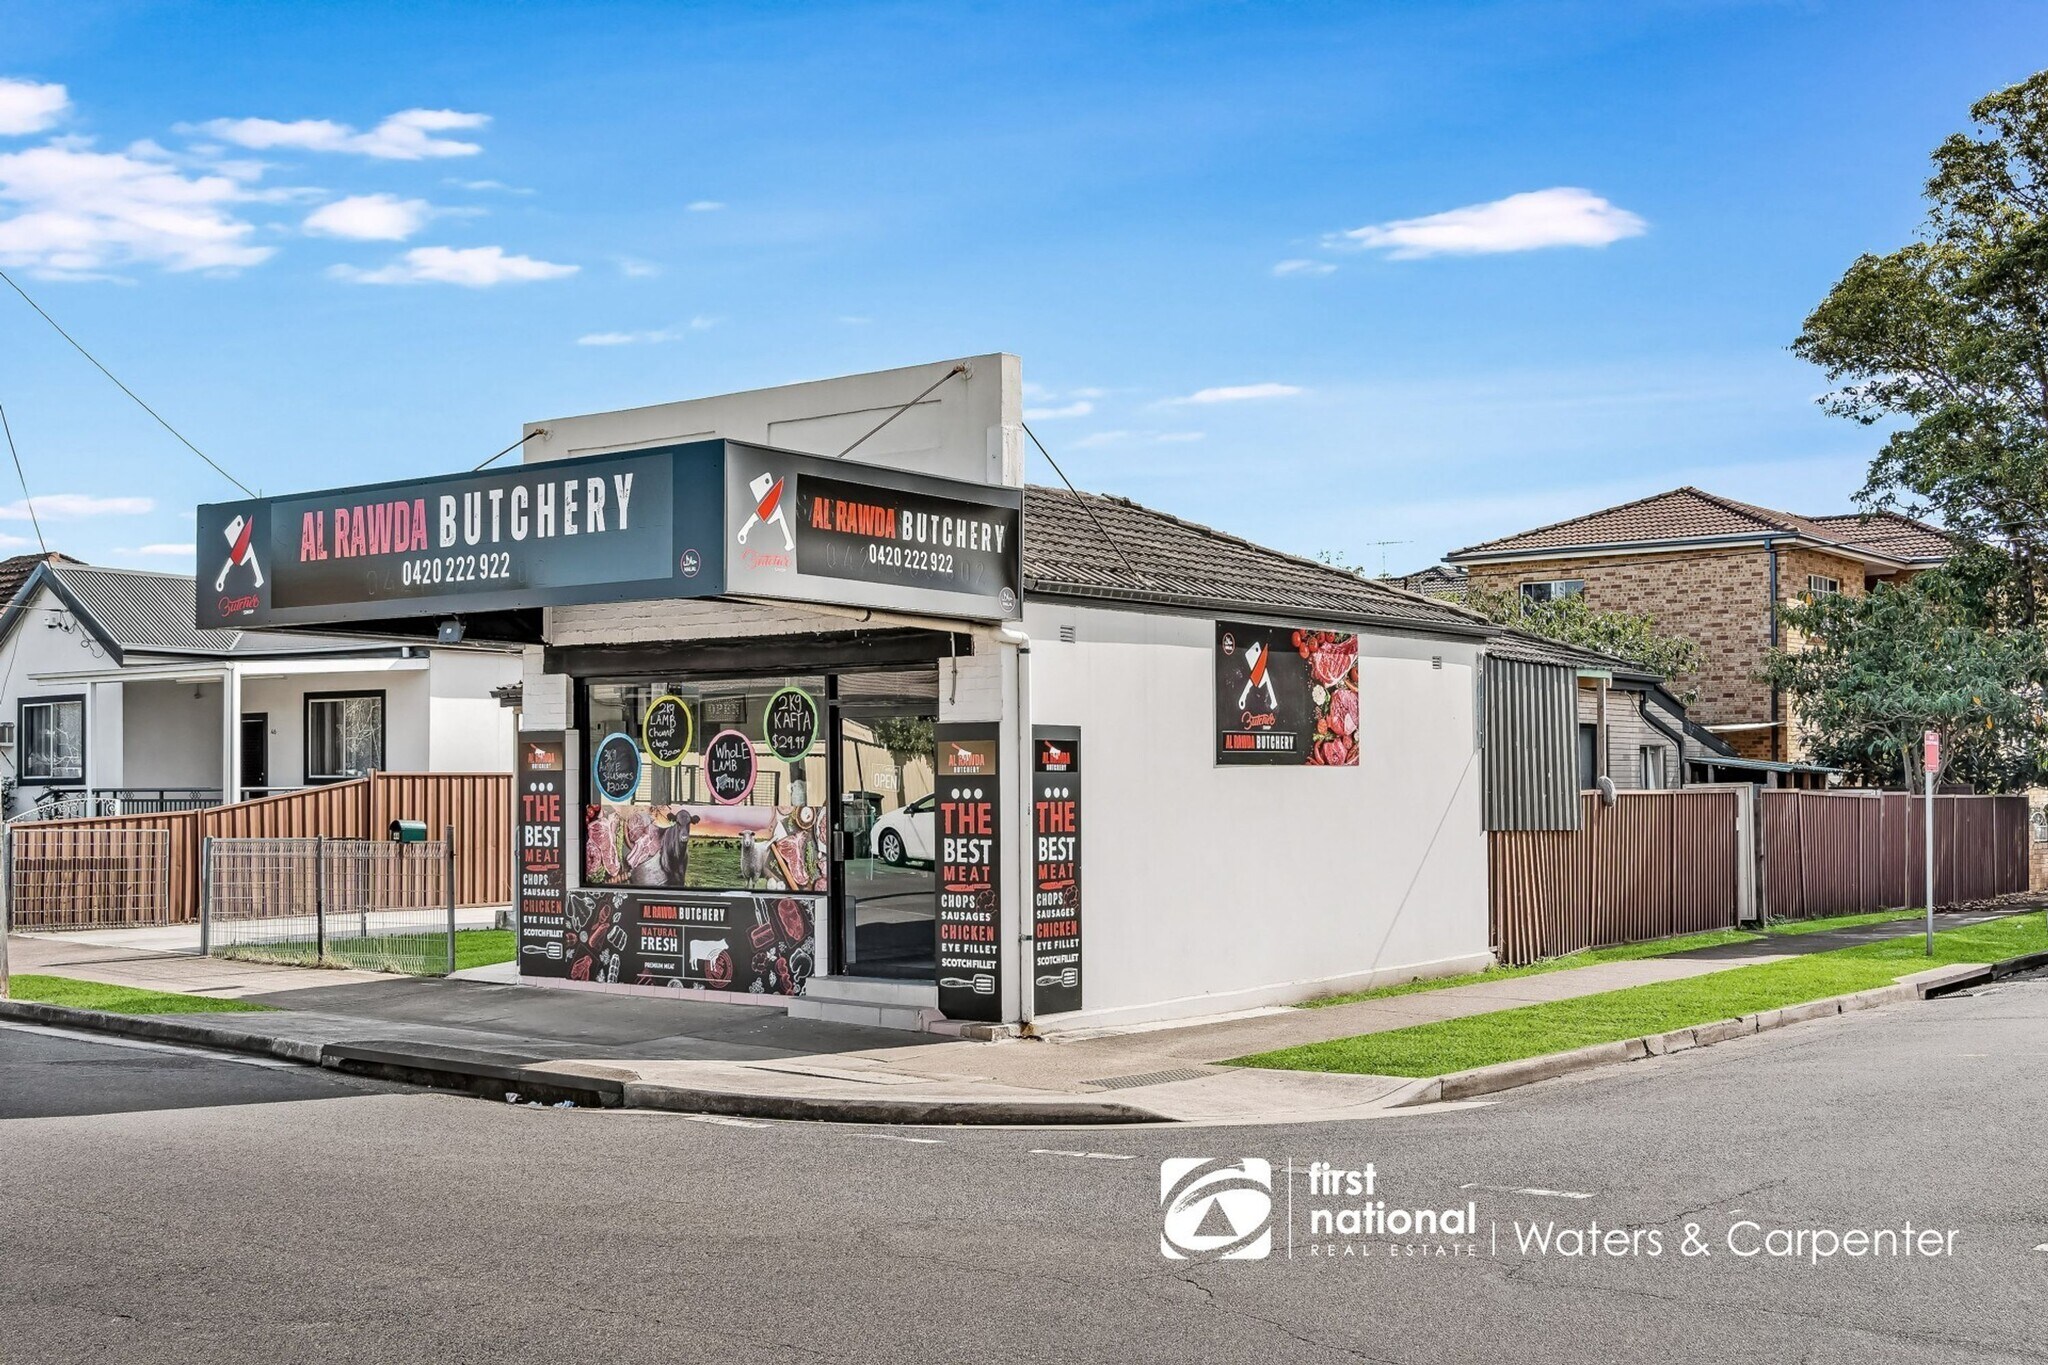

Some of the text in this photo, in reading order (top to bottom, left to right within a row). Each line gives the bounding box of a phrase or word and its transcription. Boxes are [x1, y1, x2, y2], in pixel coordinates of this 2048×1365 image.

[300, 473, 634, 562] AL RAWDA BUTCHERY
[812, 496, 1005, 554] AL RAWDA BUTCHERY
[869, 543, 902, 567] 0420
[904, 549, 928, 571] 222
[930, 554, 954, 573] 922
[402, 558, 442, 586] 0420
[446, 555, 476, 583] 222
[479, 551, 511, 580] 922
[650, 714, 677, 729] LAMB
[774, 710, 811, 731] KAFTA
[772, 733, 806, 750] $29.99
[1256, 735, 1294, 750] BUTCHERY
[712, 759, 738, 772] LAMB
[873, 772, 898, 790] OPEN
[522, 794, 560, 822] THE
[941, 803, 993, 835] THE
[1036, 801, 1076, 833] THE
[525, 825, 561, 848] BEST
[525, 848, 559, 863] MEAT
[943, 837, 993, 865] BEST
[1038, 835, 1076, 862] BEST
[943, 865, 990, 882] MEAT
[1038, 862, 1075, 880] MEAT
[523, 873, 549, 886] CHOPS
[523, 887, 560, 897] SAUSAGES
[1036, 891, 1063, 907] CHOPS
[523, 898, 562, 914] CHICKEN
[941, 893, 975, 909] CHOPS
[523, 915, 565, 925] EYE FILLET
[678, 907, 725, 922] BUTCHERY
[941, 910, 991, 922] SAUSAGES
[1036, 907, 1075, 919] SAUSAGES
[641, 927, 678, 938] NATURAL
[941, 924, 994, 942] CHICKEN
[1036, 920, 1077, 939] CHICKEN
[641, 936, 678, 952] FRESH
[941, 942, 997, 954] EYE FILLET
[1036, 938, 1080, 952] EYE FILLET
